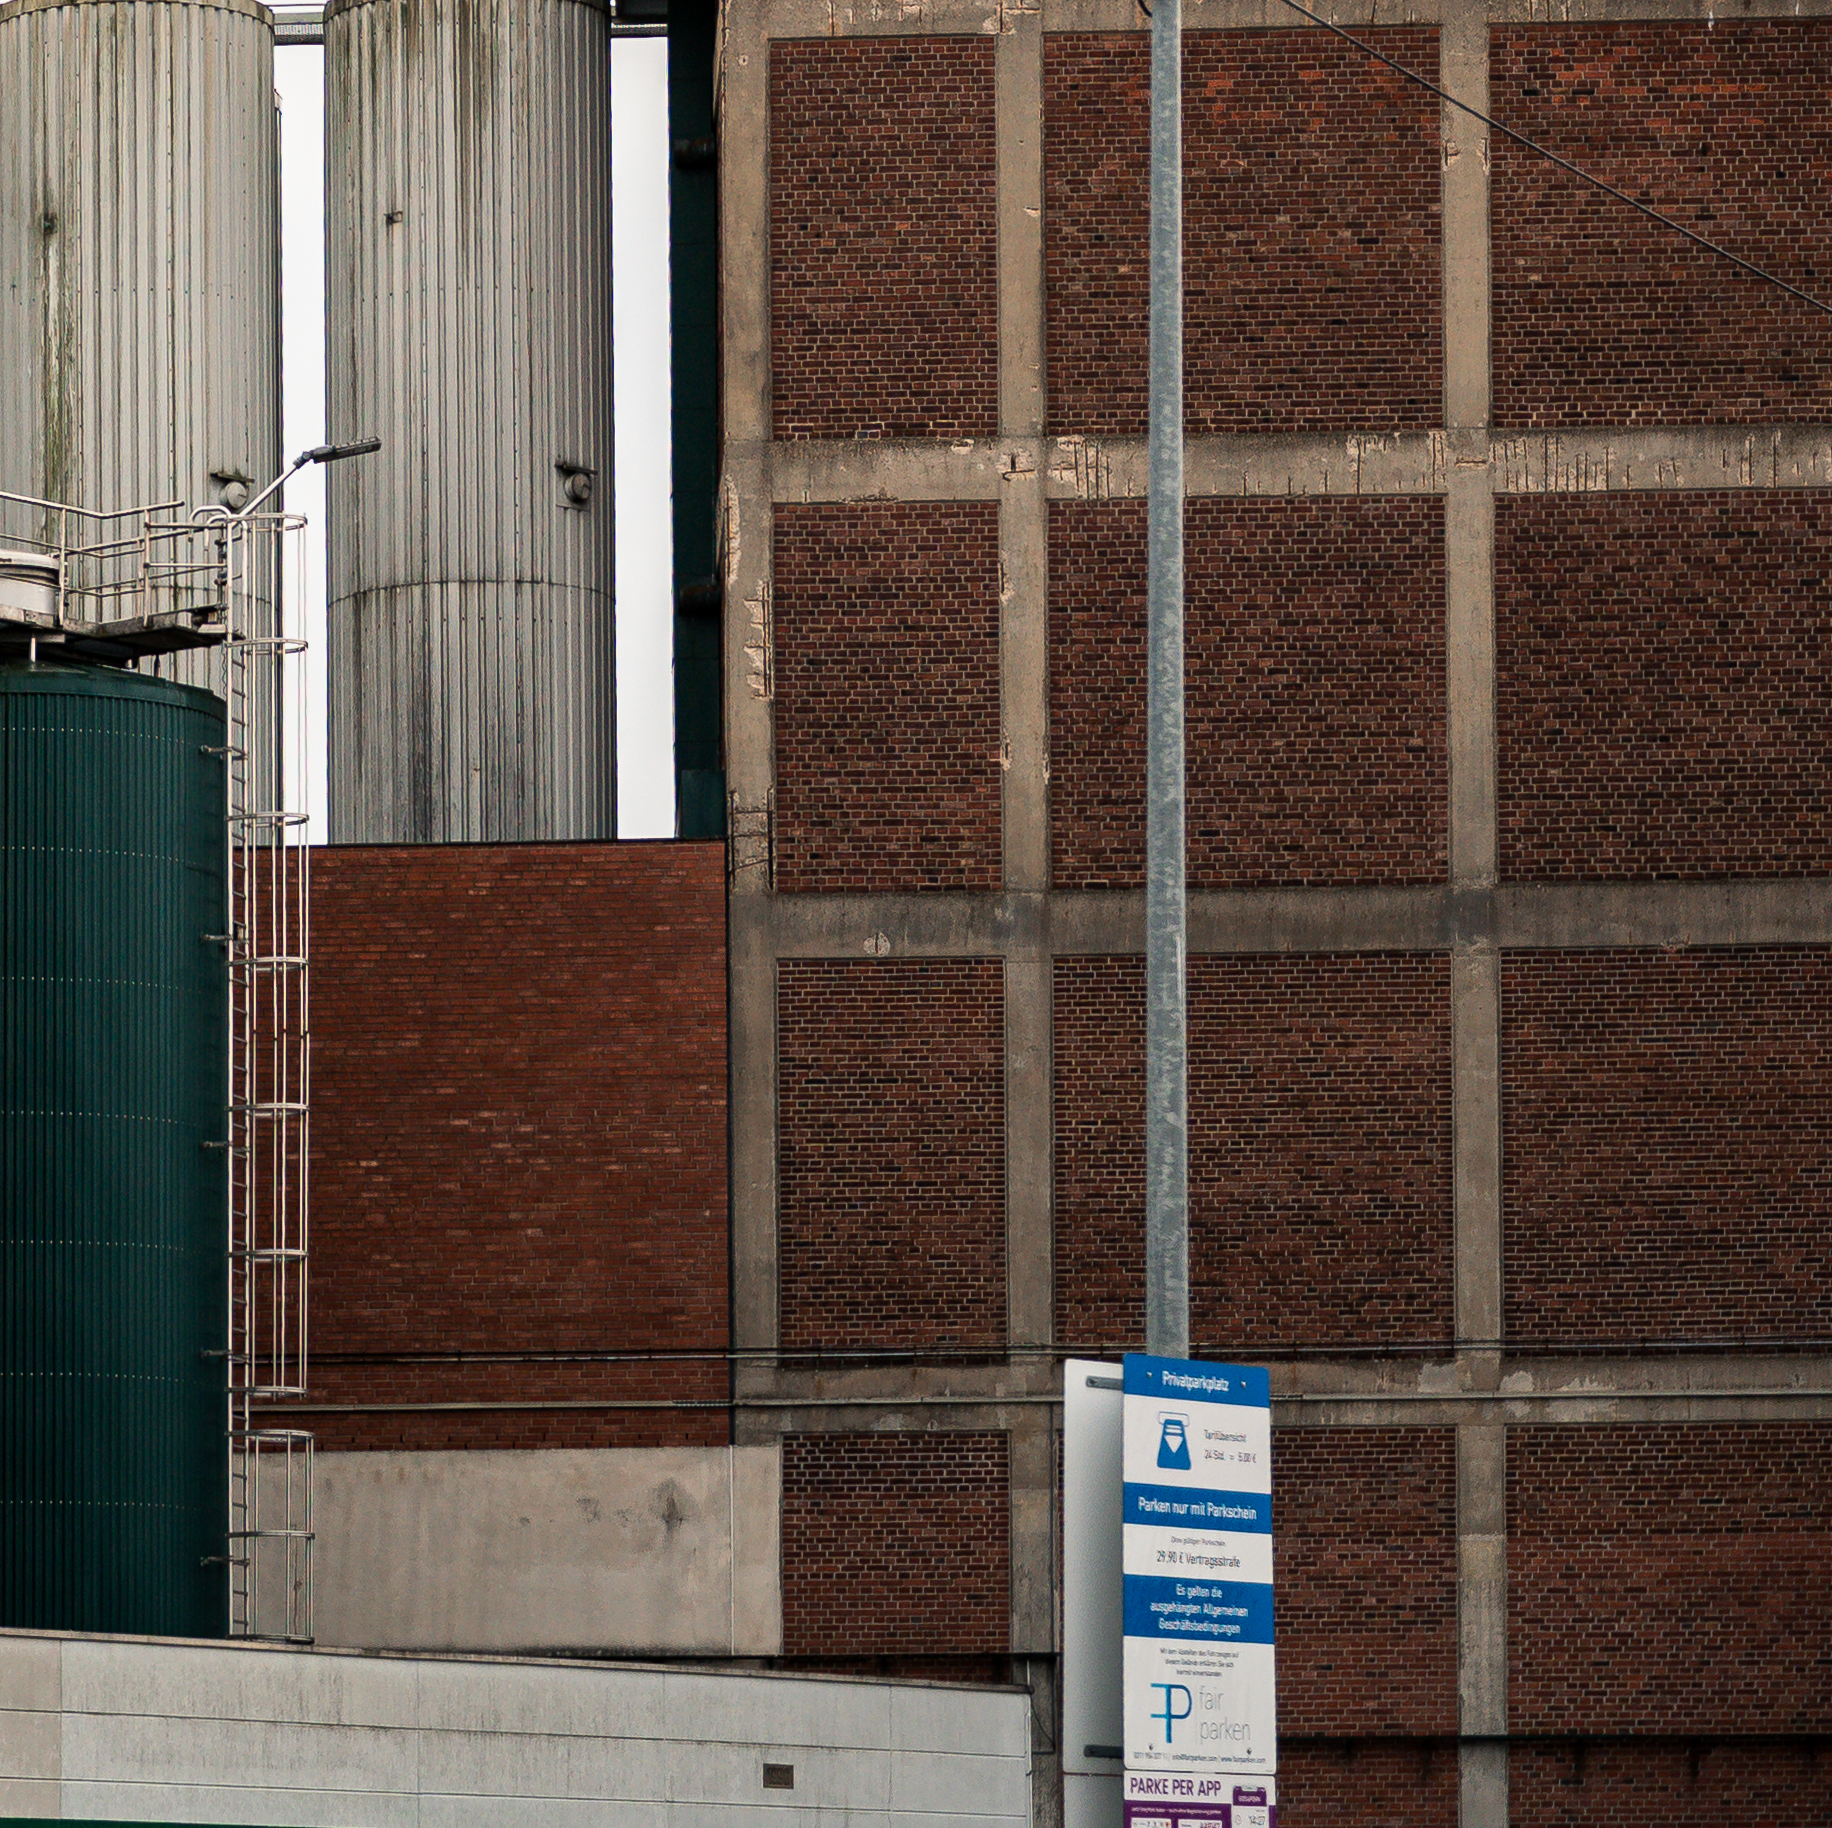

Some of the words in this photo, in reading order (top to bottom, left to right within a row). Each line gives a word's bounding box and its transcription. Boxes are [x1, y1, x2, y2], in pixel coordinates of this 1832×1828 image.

[1162, 1370, 1229, 1393] Privatparkplatz
[1138, 1496, 1171, 1513] Parken
[1172, 1502, 1188, 1514] nur
[1190, 1502, 1205, 1516] mit
[1207, 1502, 1257, 1520] Parkschein
[1185, 1552, 1241, 1569] Vertragsstrafe
[1176, 1584, 1186, 1596] Es
[1199, 1685, 1224, 1711] fair
[1199, 1716, 1251, 1745] parken
[1130, 1777, 1169, 1795] PARKE
[1172, 1779, 1194, 1796] PER
[1198, 1780, 1222, 1797] APP
